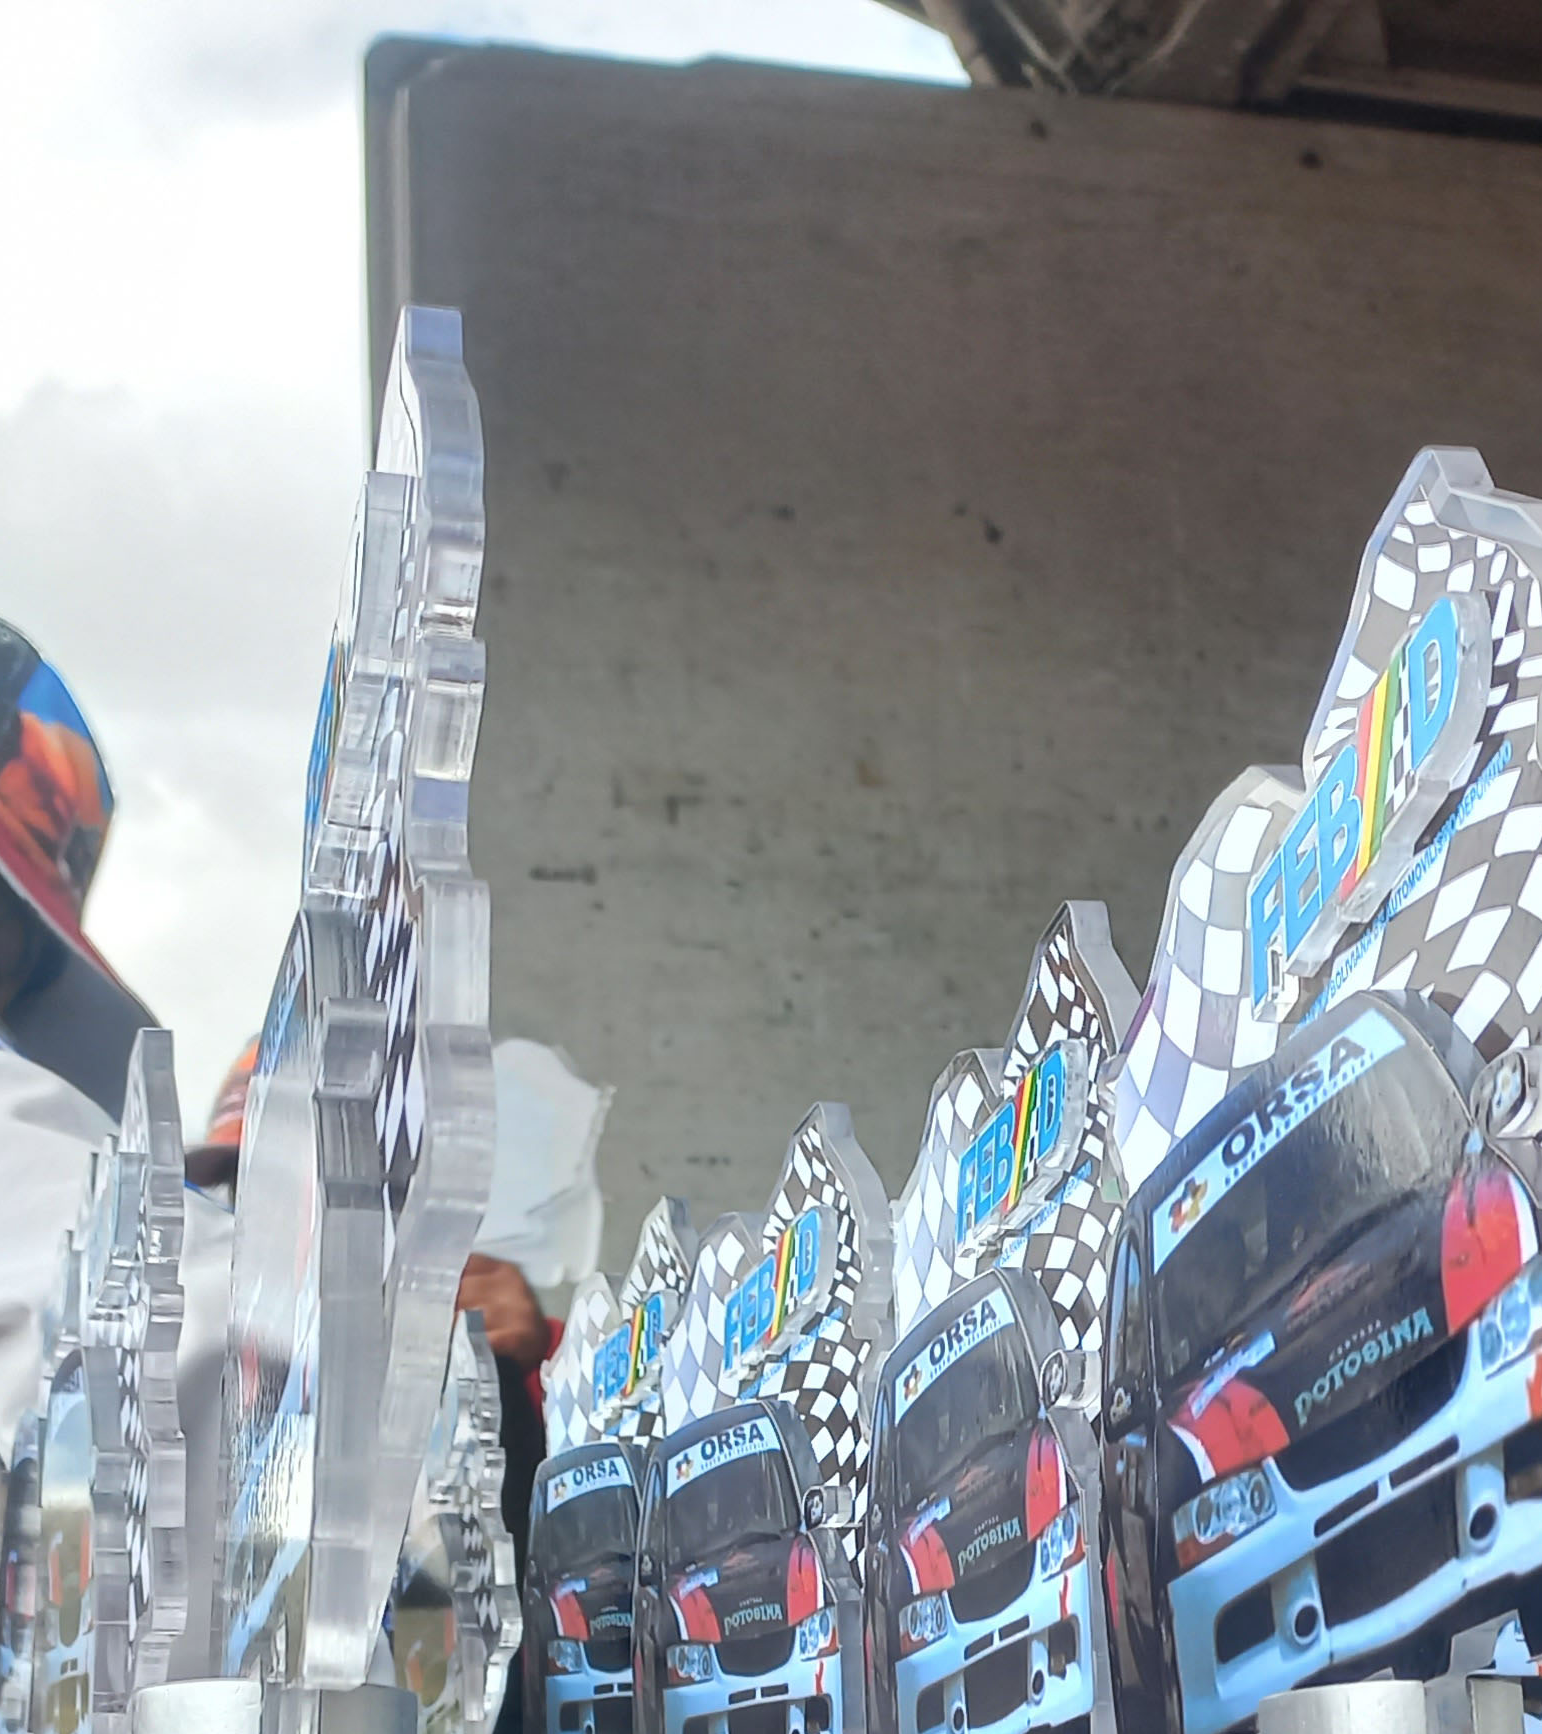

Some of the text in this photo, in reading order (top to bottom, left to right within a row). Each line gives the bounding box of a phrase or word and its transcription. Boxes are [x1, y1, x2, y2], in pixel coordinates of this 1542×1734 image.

[1221, 1035, 1367, 1168] ORSA
[929, 1299, 997, 1366] ORSA
[700, 1422, 766, 1461] ORSA
[572, 1459, 620, 1486] ORSA
